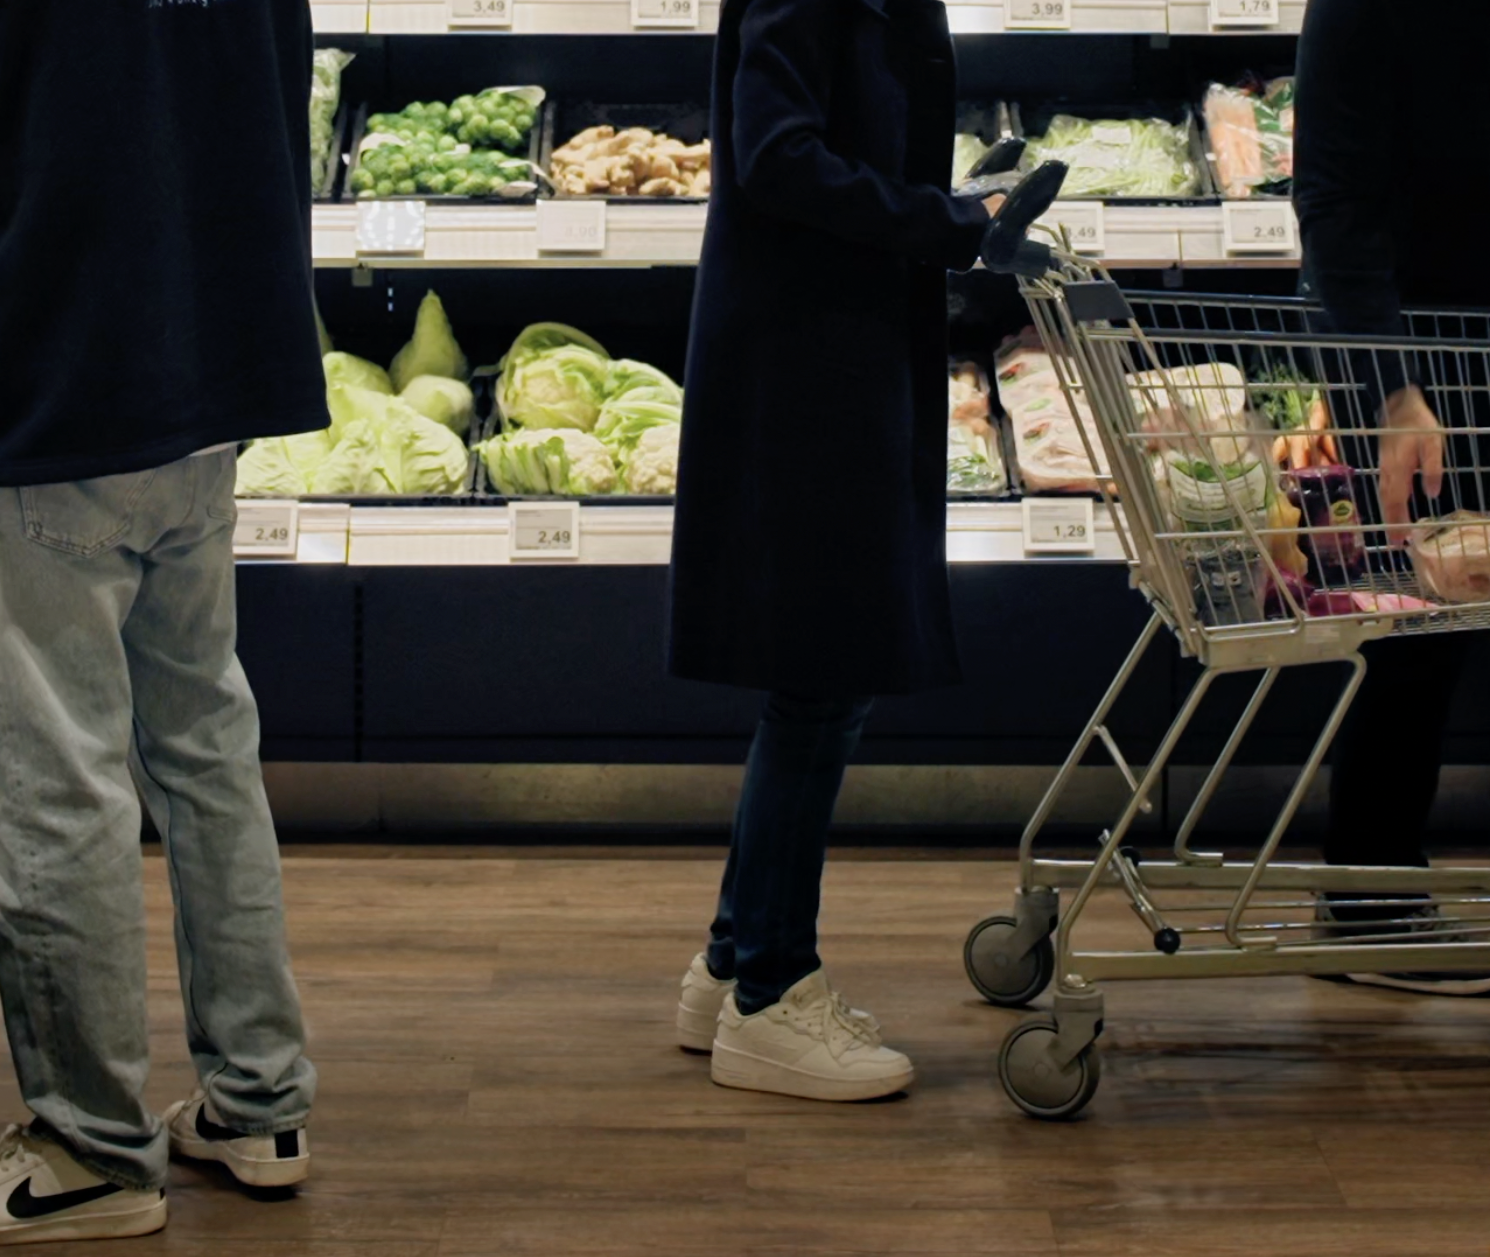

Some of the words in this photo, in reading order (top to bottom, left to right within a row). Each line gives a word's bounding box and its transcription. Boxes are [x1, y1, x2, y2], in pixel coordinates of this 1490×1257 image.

[473, 0, 505, 15] 3,49
[659, 0, 691, 15] 1,99
[1031, 2, 1063, 16] 3,99
[1239, 0, 1271, 14] 1,79
[1253, 226, 1286, 239] 2,49
[255, 527, 288, 542] 2,49
[537, 530, 571, 545] 2,49
[1053, 525, 1086, 539] 1,29
